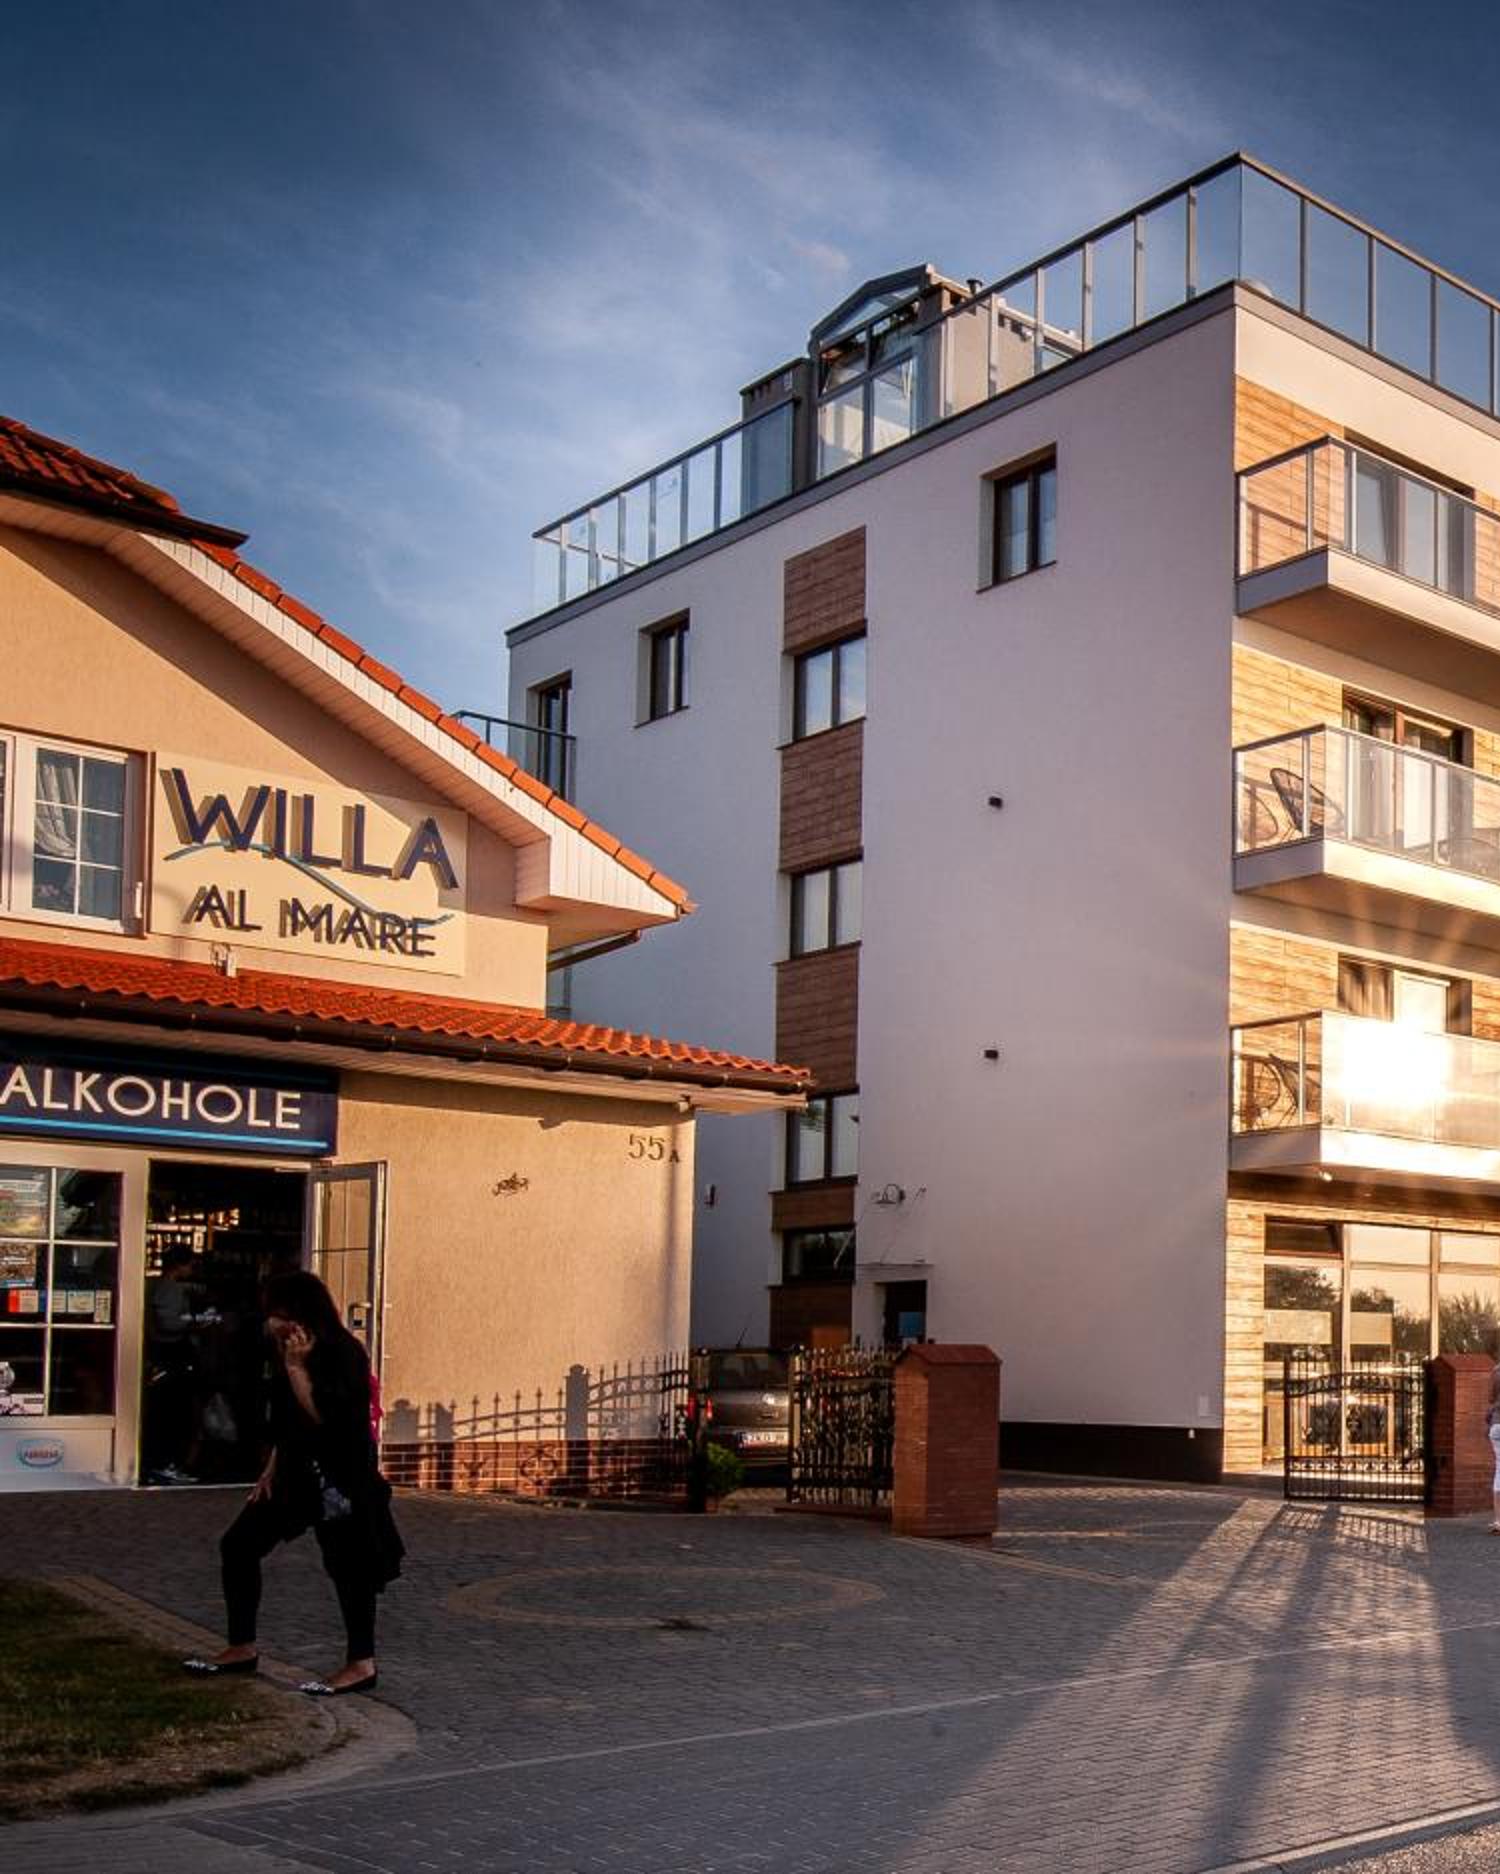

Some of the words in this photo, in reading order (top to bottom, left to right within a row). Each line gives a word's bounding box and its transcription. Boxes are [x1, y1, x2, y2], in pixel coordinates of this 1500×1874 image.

[170, 767, 459, 889] WILLA
[194, 884, 263, 932] AL
[290, 897, 437, 957] MARE
[0, 1065, 301, 1130] ALKOHOLE
